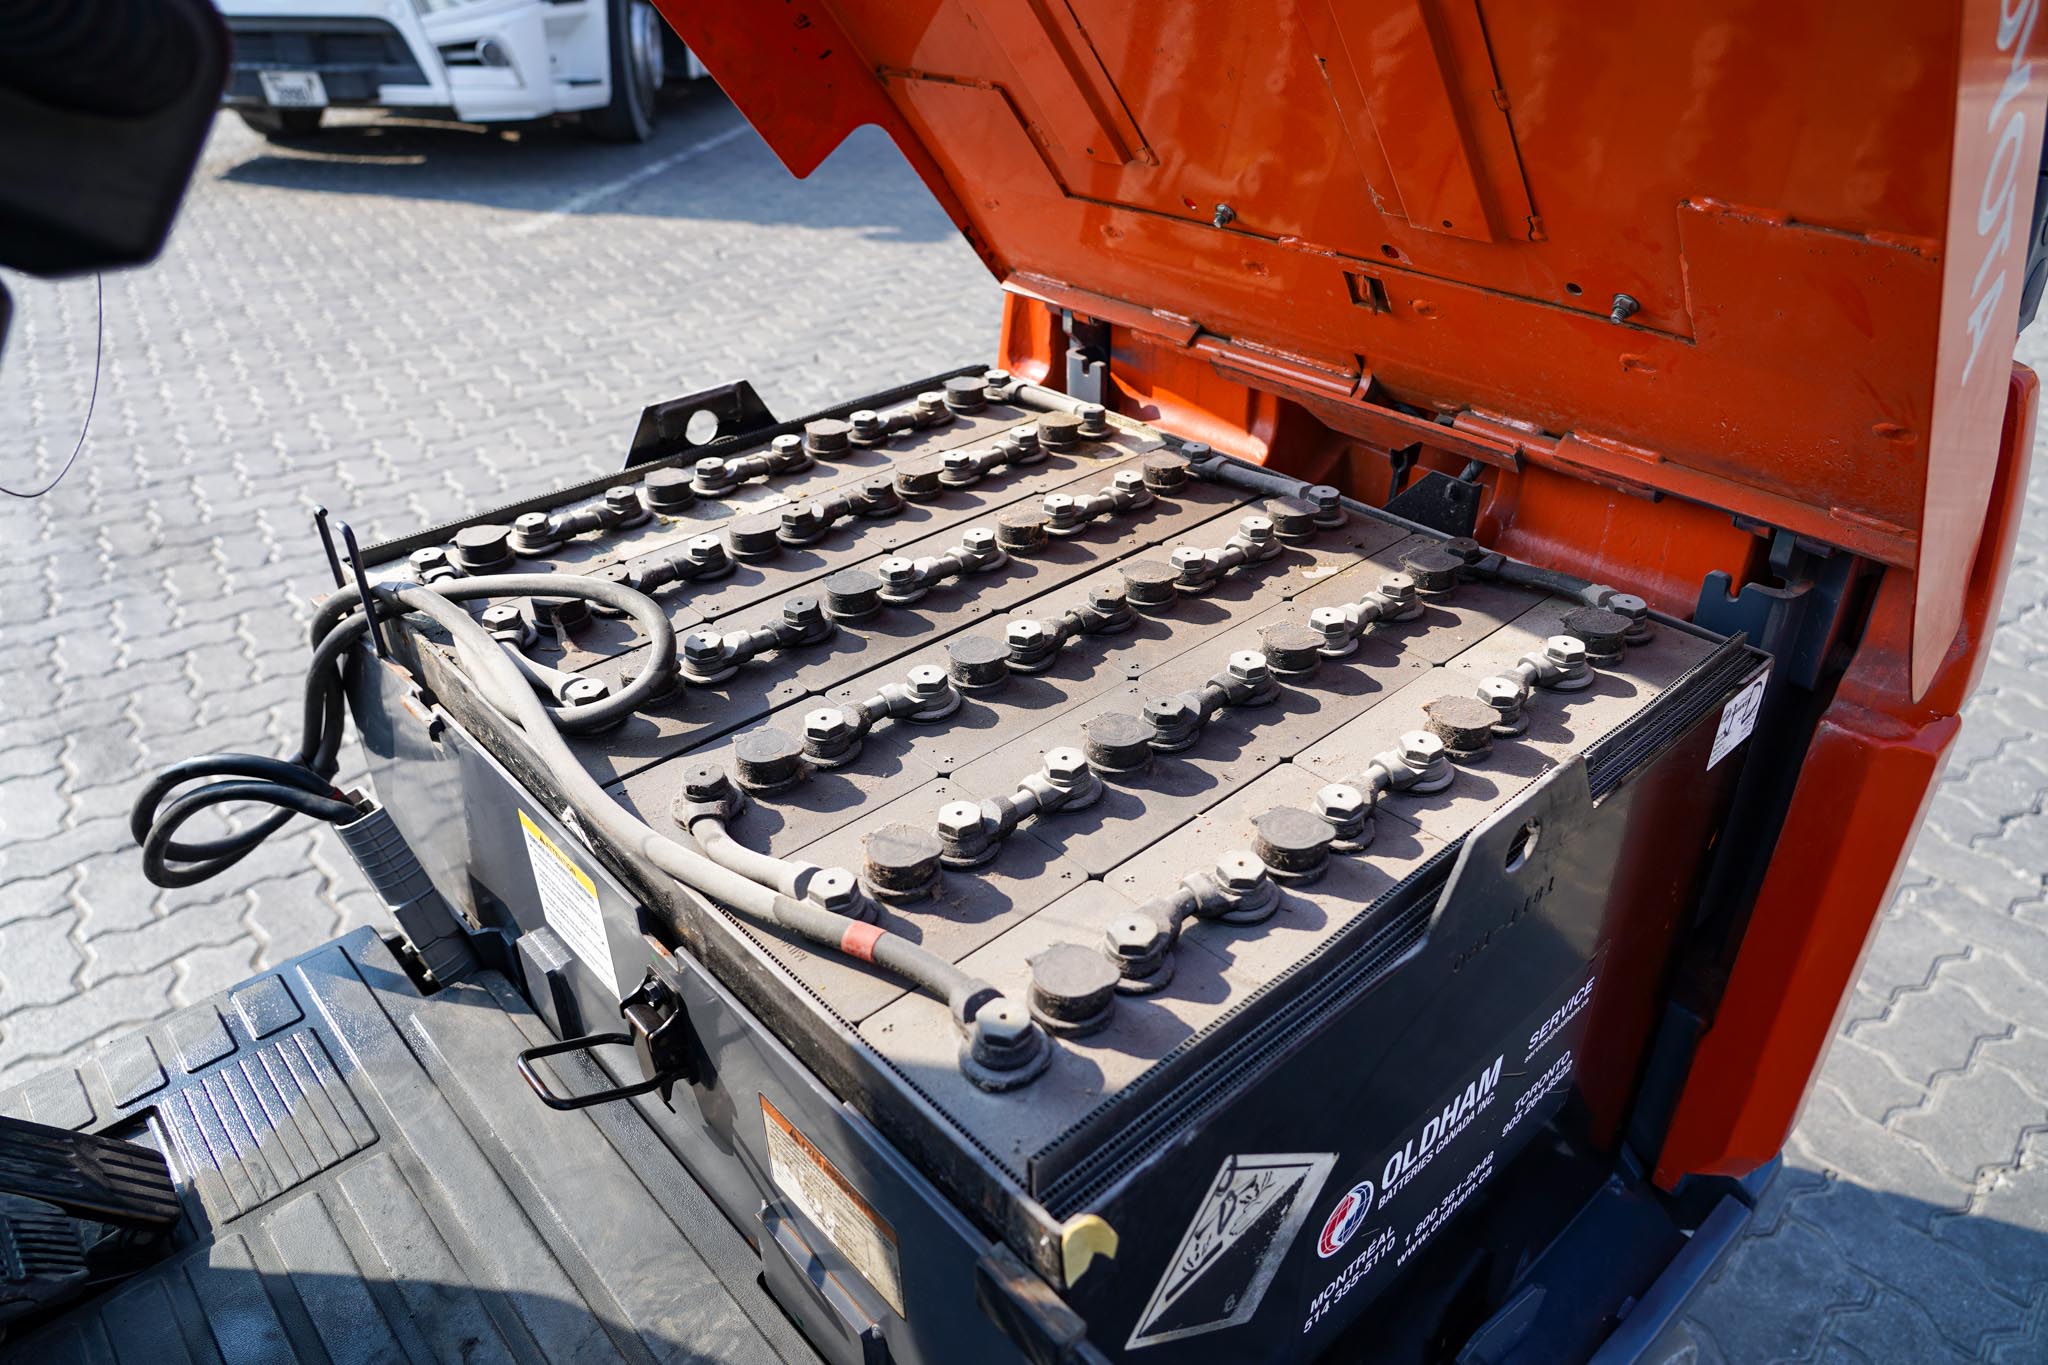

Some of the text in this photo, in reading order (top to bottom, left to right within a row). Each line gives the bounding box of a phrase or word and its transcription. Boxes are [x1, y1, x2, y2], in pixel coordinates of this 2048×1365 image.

[1528, 976, 1595, 1050] SERVICE
[1381, 1054, 1504, 1190] OLDHAM
[1502, 1112, 1522, 1137] 905
[1514, 1050, 1571, 1112] TORONTO
[1378, 1091, 1495, 1210] BATTERIES CANADA INC.
[1404, 1150, 1494, 1246] 1 800 361-2048
[1397, 1165, 1493, 1267] www.oldham.ca
[1303, 1236, 1396, 1334] 514 355-5110
[1310, 1226, 1395, 1313] MONTRÉAL
